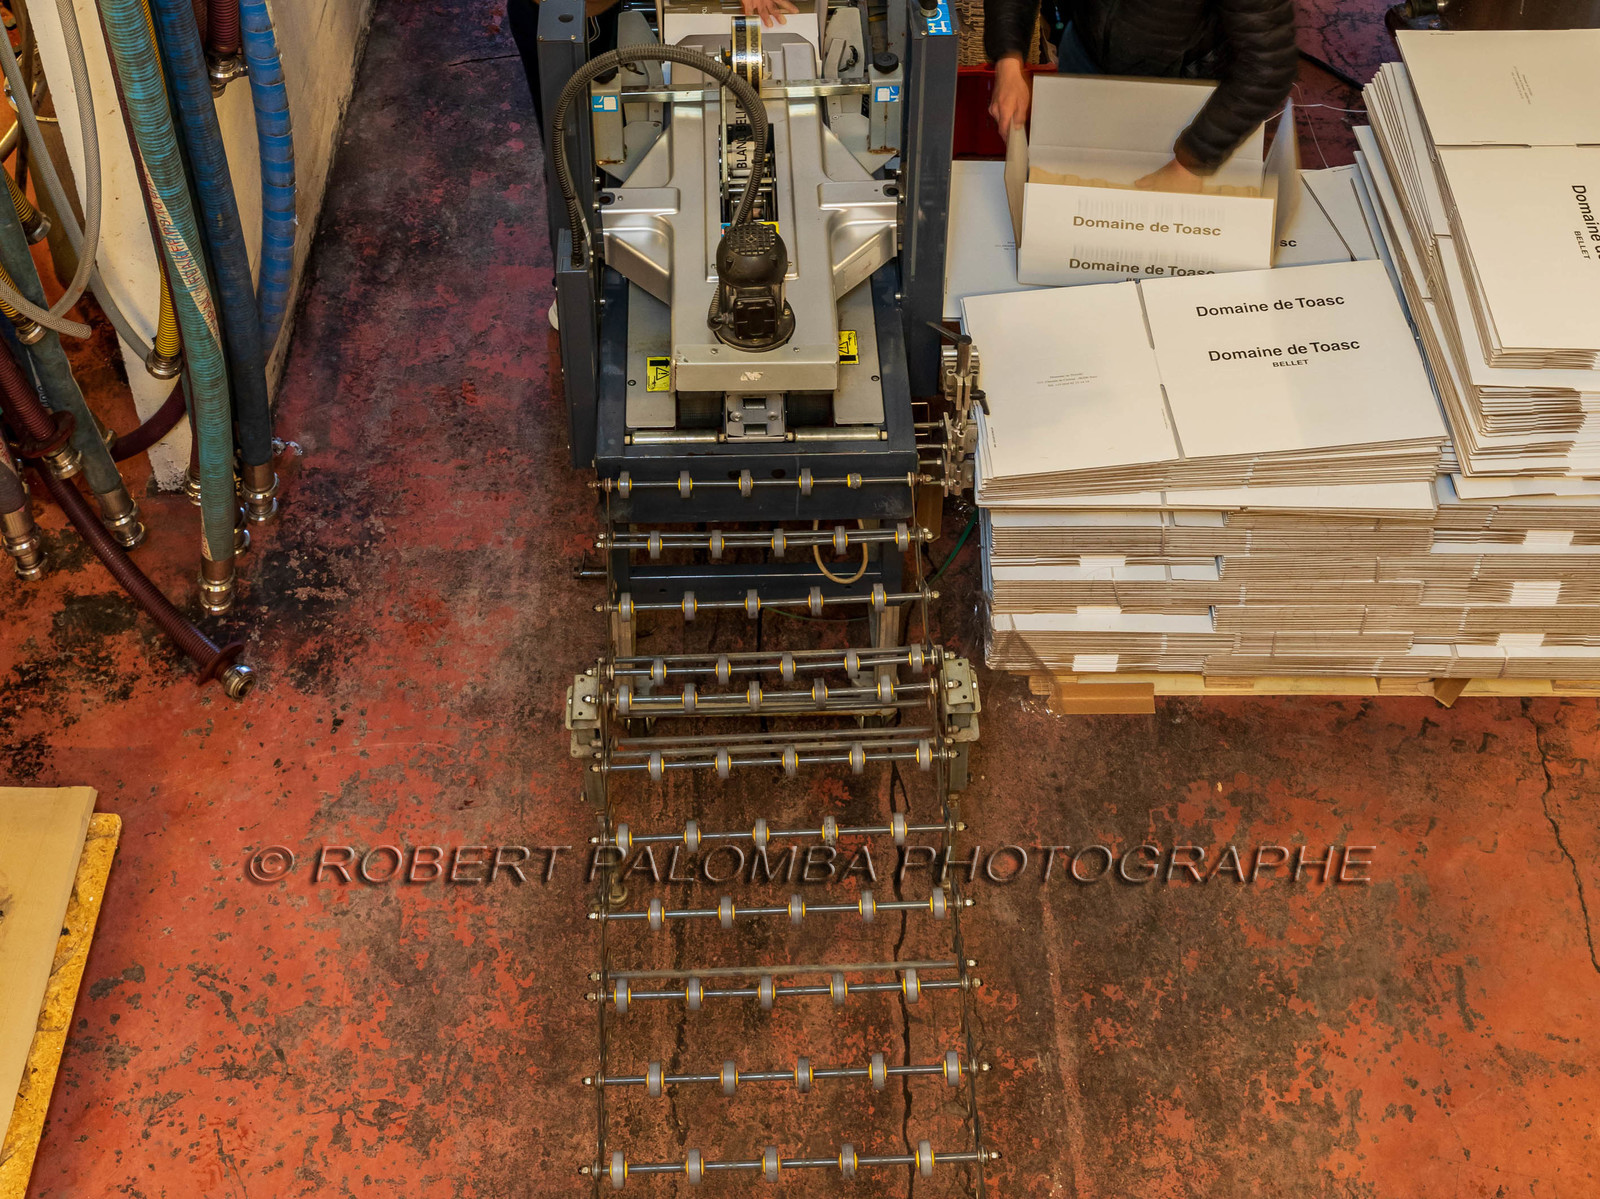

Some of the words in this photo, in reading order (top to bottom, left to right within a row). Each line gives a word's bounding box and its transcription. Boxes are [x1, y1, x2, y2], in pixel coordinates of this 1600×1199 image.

[1572, 184, 1600, 242] Domaine
[1073, 215, 1145, 231] Domaine
[1149, 222, 1170, 233] de
[1173, 223, 1222, 236] Toasc
[1574, 230, 1591, 260] BELLET
[1069, 258, 1140, 274] Domaine
[1144, 265, 1165, 276] de
[1196, 302, 1269, 317] Domaine
[1273, 299, 1294, 311] de
[1295, 296, 1345, 309] Toasc
[1208, 346, 1283, 362] Domaine
[1287, 344, 1308, 355] de
[1309, 340, 1361, 353] Toasc
[1272, 359, 1309, 368] BELLET
